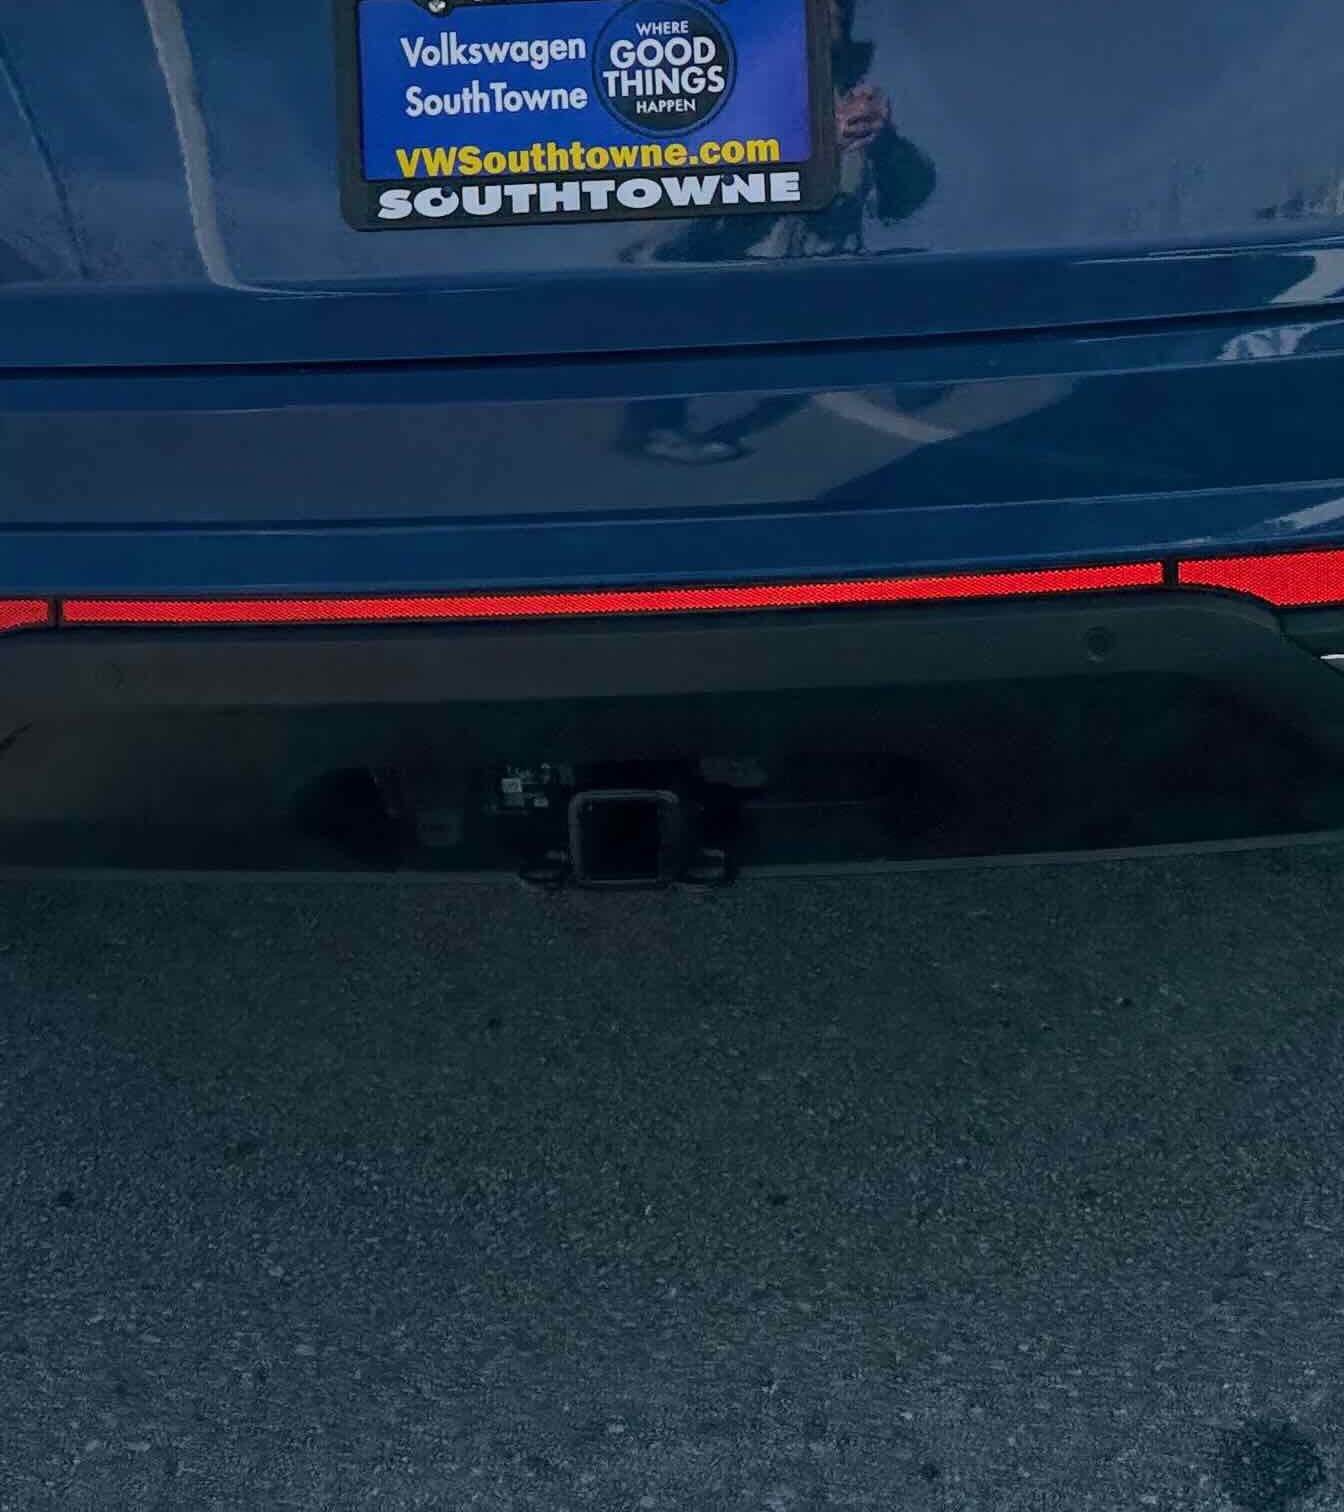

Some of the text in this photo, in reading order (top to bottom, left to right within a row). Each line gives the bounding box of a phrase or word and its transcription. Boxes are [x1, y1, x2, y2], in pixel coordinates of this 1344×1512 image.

[635, 19, 690, 36] WHERE
[400, 33, 587, 71] Volkswagen
[609, 37, 716, 68] GOOD
[405, 80, 588, 118] SouthTowne
[602, 65, 726, 98] THINGS
[635, 98, 697, 114] HAPPEN
[396, 138, 780, 178] VWSouthtowne.com
[377, 171, 801, 221] SOUTHTOWNE
